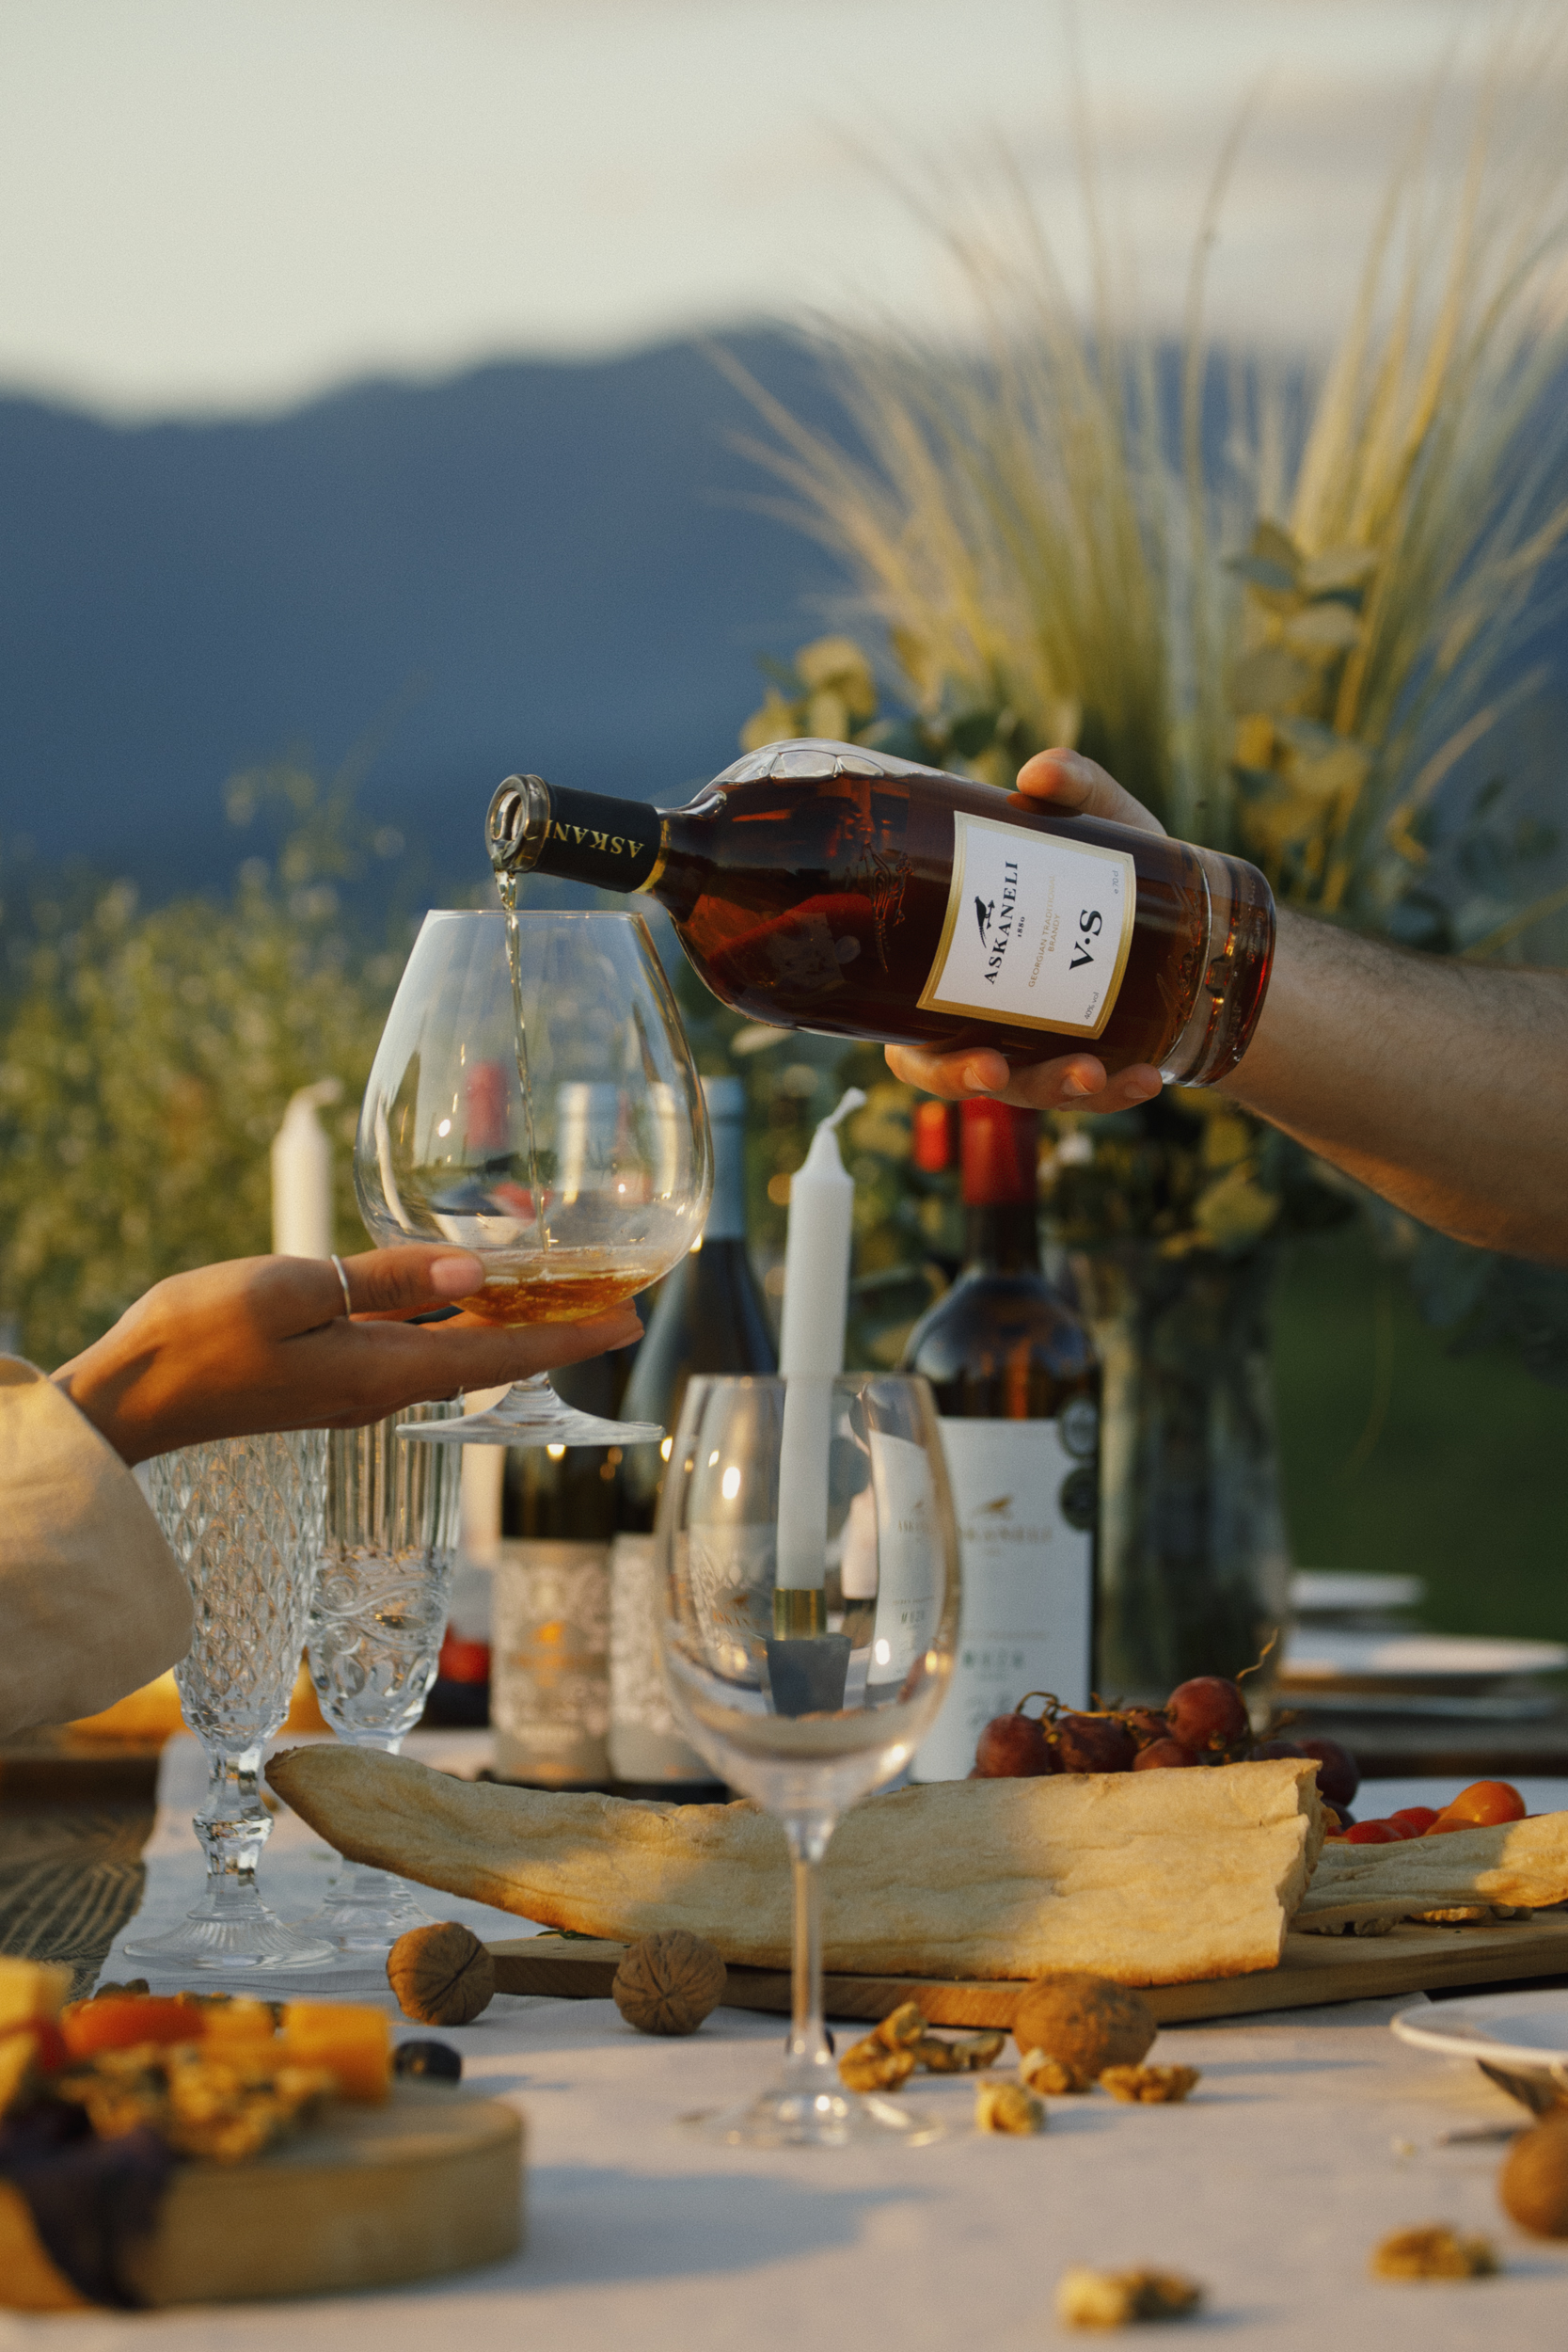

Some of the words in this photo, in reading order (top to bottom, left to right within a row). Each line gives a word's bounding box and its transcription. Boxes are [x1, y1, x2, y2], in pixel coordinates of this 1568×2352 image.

[984, 861, 1019, 985] ASKANELI
[1017, 916, 1025, 938] 1880
[1028, 940, 1047, 988] GEORGIAN
[1042, 875, 1056, 937] TRADITIONAL
[1048, 914, 1061, 952] BRANDY
[1084, 1004, 1096, 1020] 40%
[1091, 992, 1100, 1004] vol
